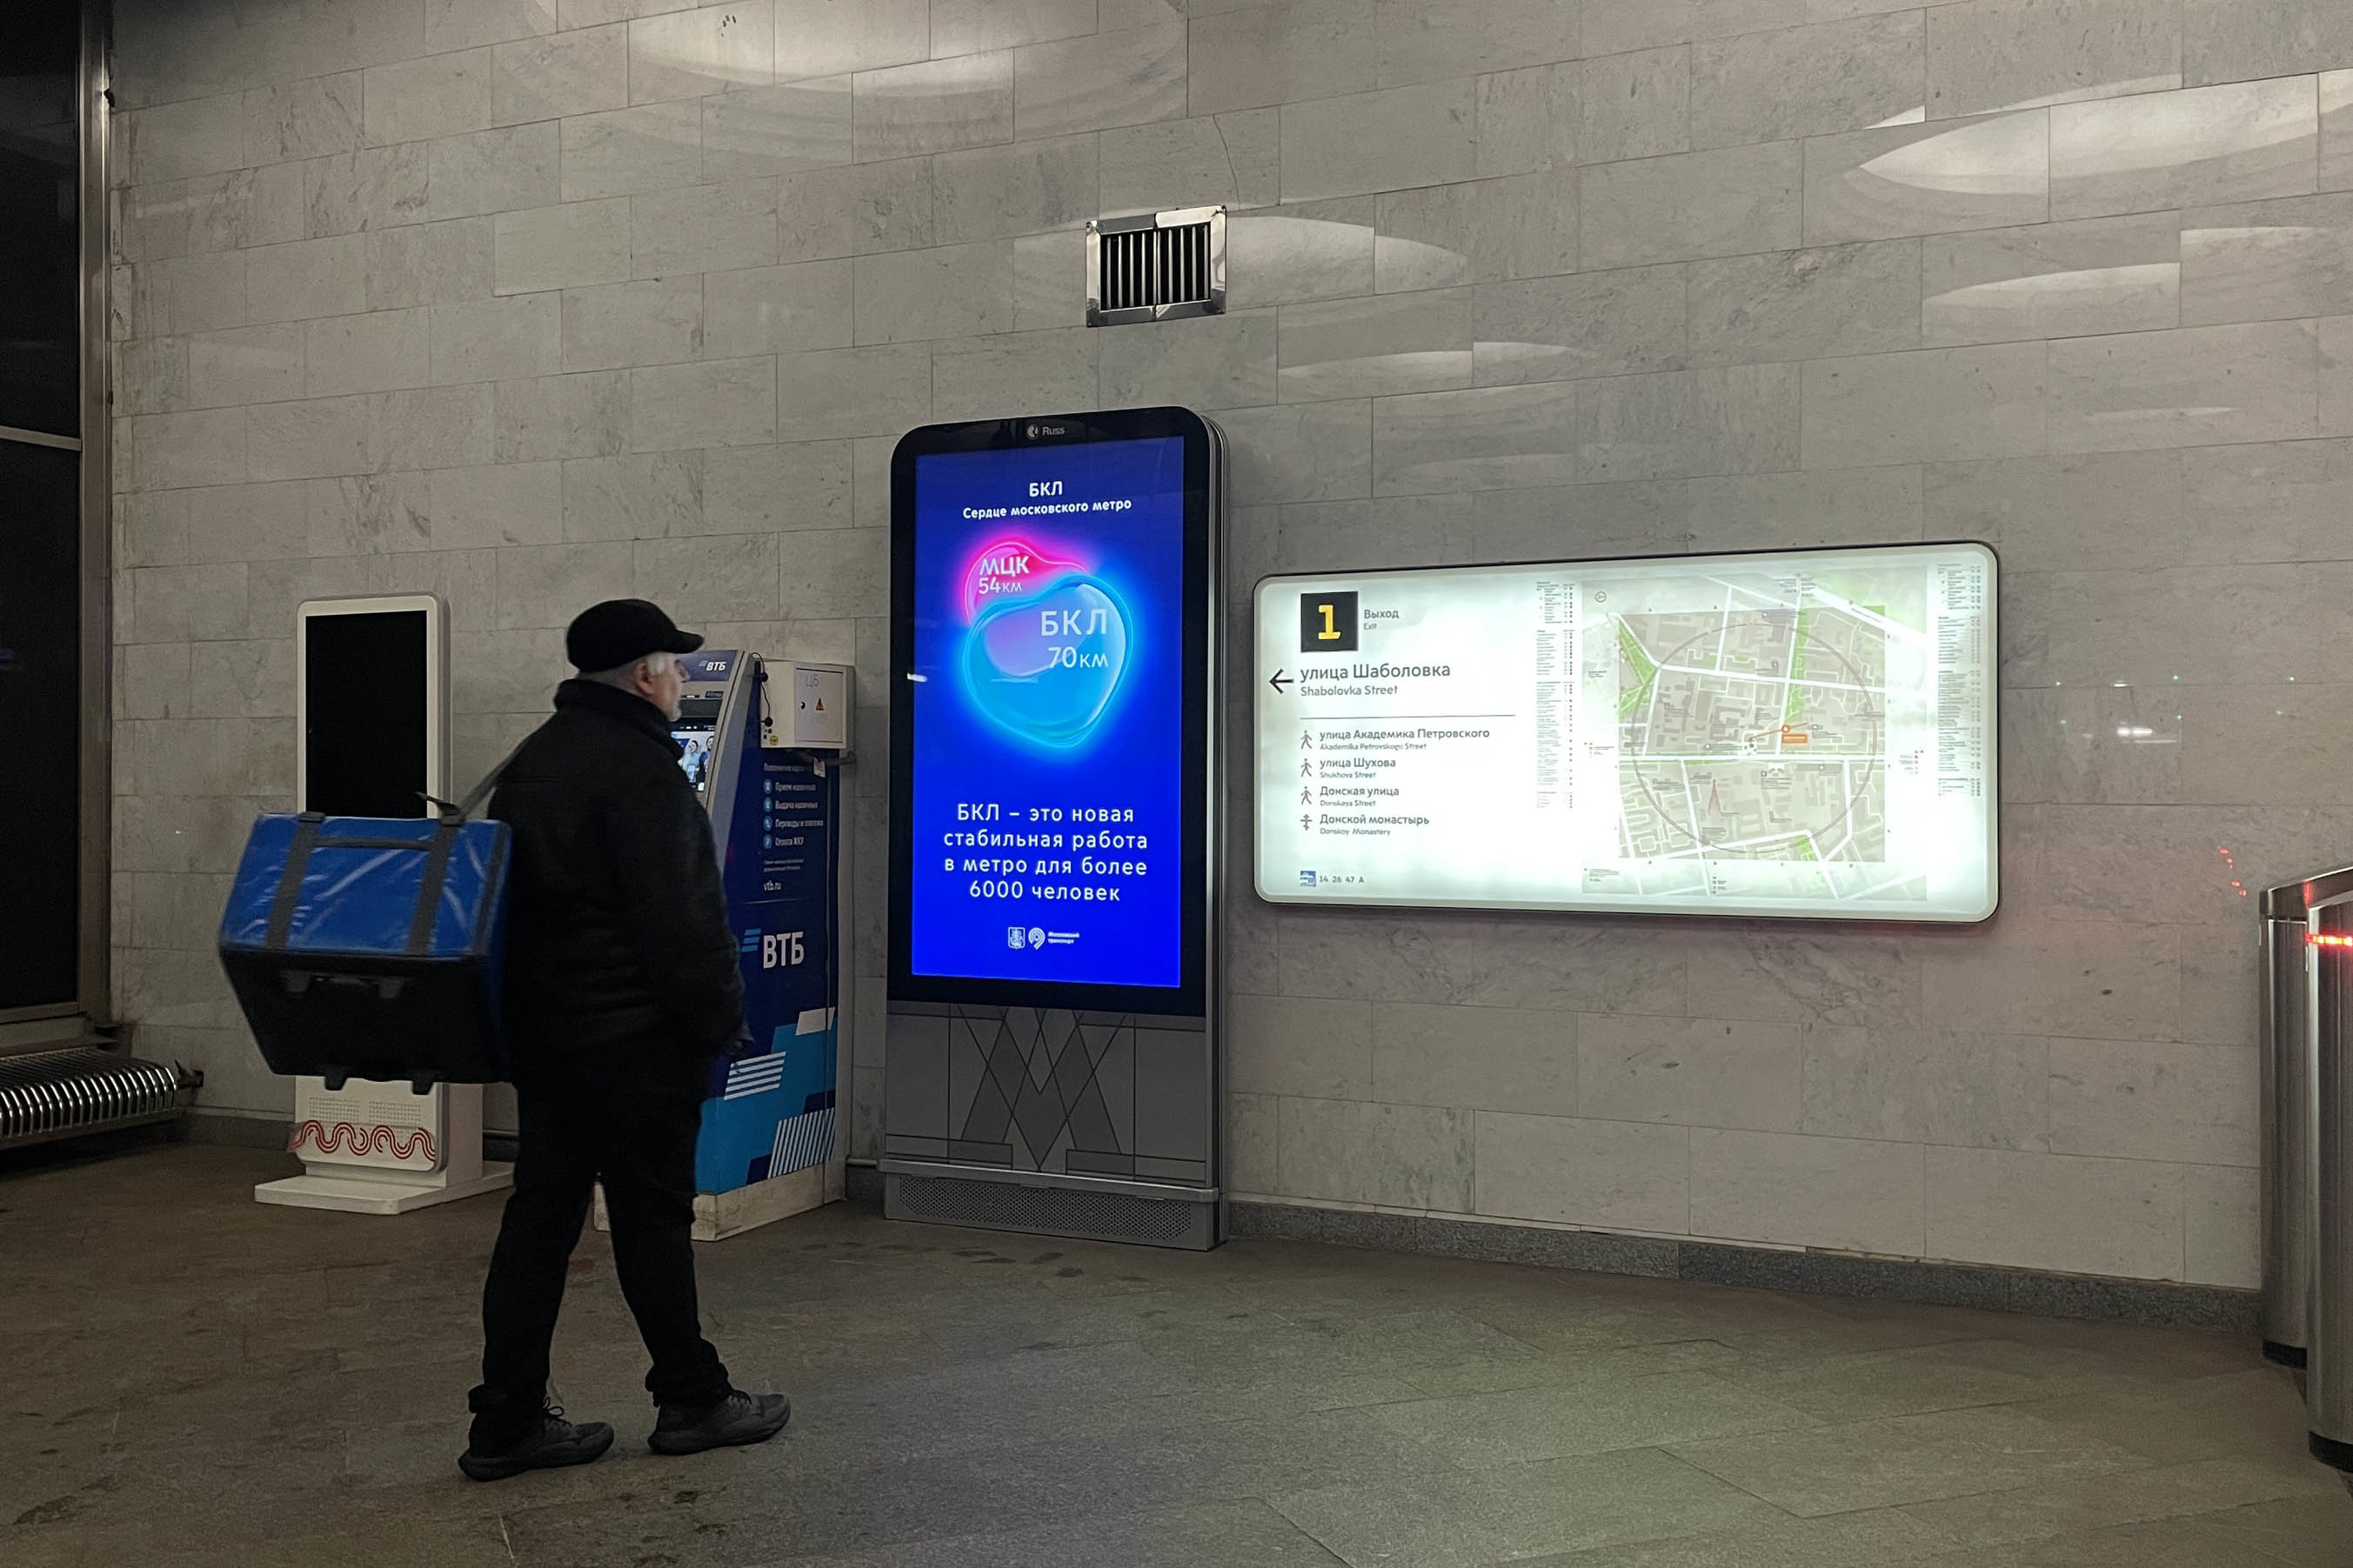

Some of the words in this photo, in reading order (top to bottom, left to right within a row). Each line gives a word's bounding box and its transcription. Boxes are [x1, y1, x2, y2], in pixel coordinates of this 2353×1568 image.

[1042, 426, 1065, 436] Russ
[1029, 480, 1063, 497] БКЛ
[963, 506, 1007, 520] Сердце
[1011, 502, 1089, 516] московского
[1093, 499, 1133, 512] метро
[979, 556, 1029, 576] МЦК
[1040, 608, 1106, 637] БКЛ
[1317, 604, 1341, 640] 1
[1364, 608, 1400, 621] Выход
[705, 661, 727, 672] ВТБ
[1300, 666, 1348, 684] улица
[1354, 663, 1451, 679] Шаболовка
[1300, 685, 1362, 697] Shabolovka
[1365, 684, 1398, 696] Street
[1320, 731, 1351, 741] улица
[1354, 730, 1414, 740] Академика
[1417, 729, 1489, 739] Петровского
[1320, 759, 1351, 769] улица
[1354, 758, 1396, 769] Шухова
[1320, 786, 1365, 797] Донская
[1367, 787, 1400, 797] улица
[957, 804, 1000, 821] БКЛ
[1029, 807, 1063, 822] это
[1073, 808, 1134, 822] новая
[1320, 814, 1367, 824] Донской
[1368, 815, 1429, 825] монастырь
[944, 829, 1064, 848] стабильная
[1072, 830, 1148, 851] работа
[944, 858, 954, 871] в
[963, 858, 1027, 876] метро
[1035, 859, 1072, 876] для
[1081, 857, 1147, 876] более
[969, 880, 1023, 898] 6000
[1032, 885, 1120, 901] человек
[762, 931, 805, 969] ВТБ
